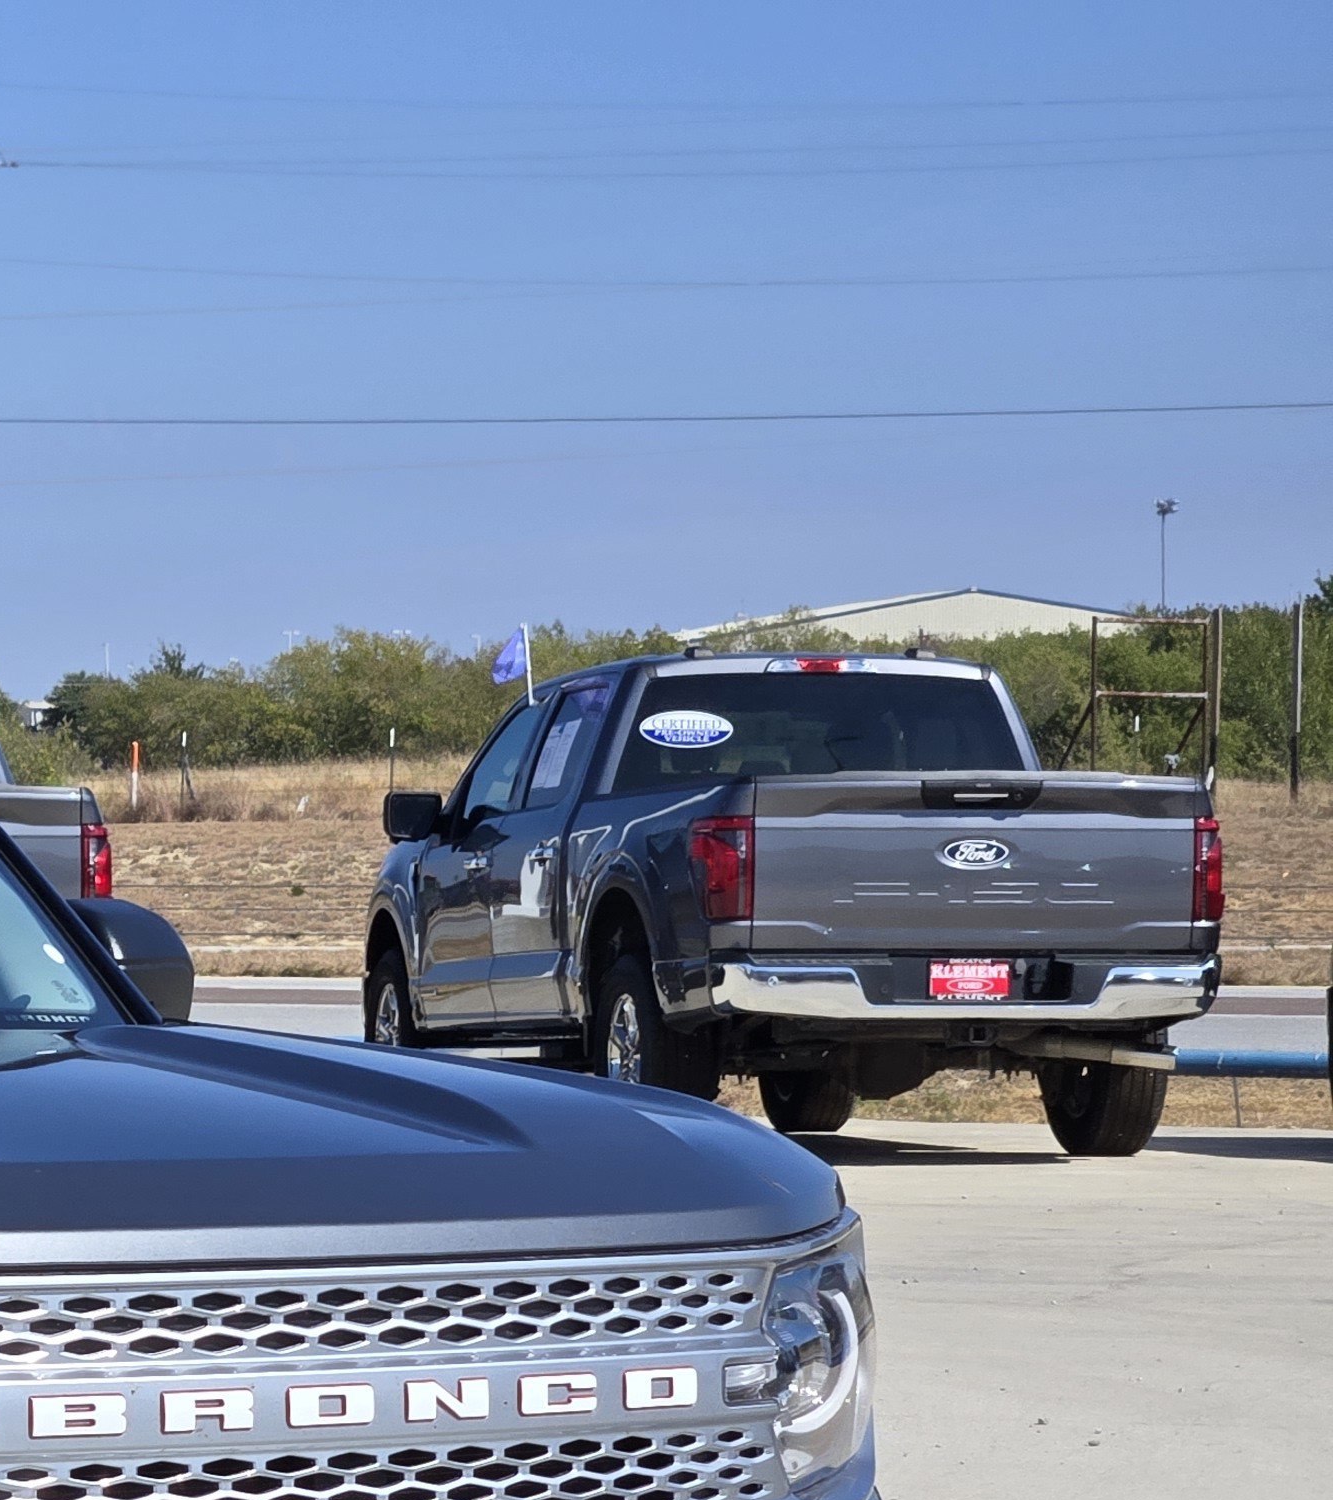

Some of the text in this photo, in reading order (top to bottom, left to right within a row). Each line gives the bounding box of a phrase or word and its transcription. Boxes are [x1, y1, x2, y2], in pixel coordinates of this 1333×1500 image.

[651, 719, 722, 729] CERTIFIED
[954, 842, 997, 862] Ford
[930, 964, 1010, 978] KLEMENT
[27, 1367, 699, 1438] BRONCO
